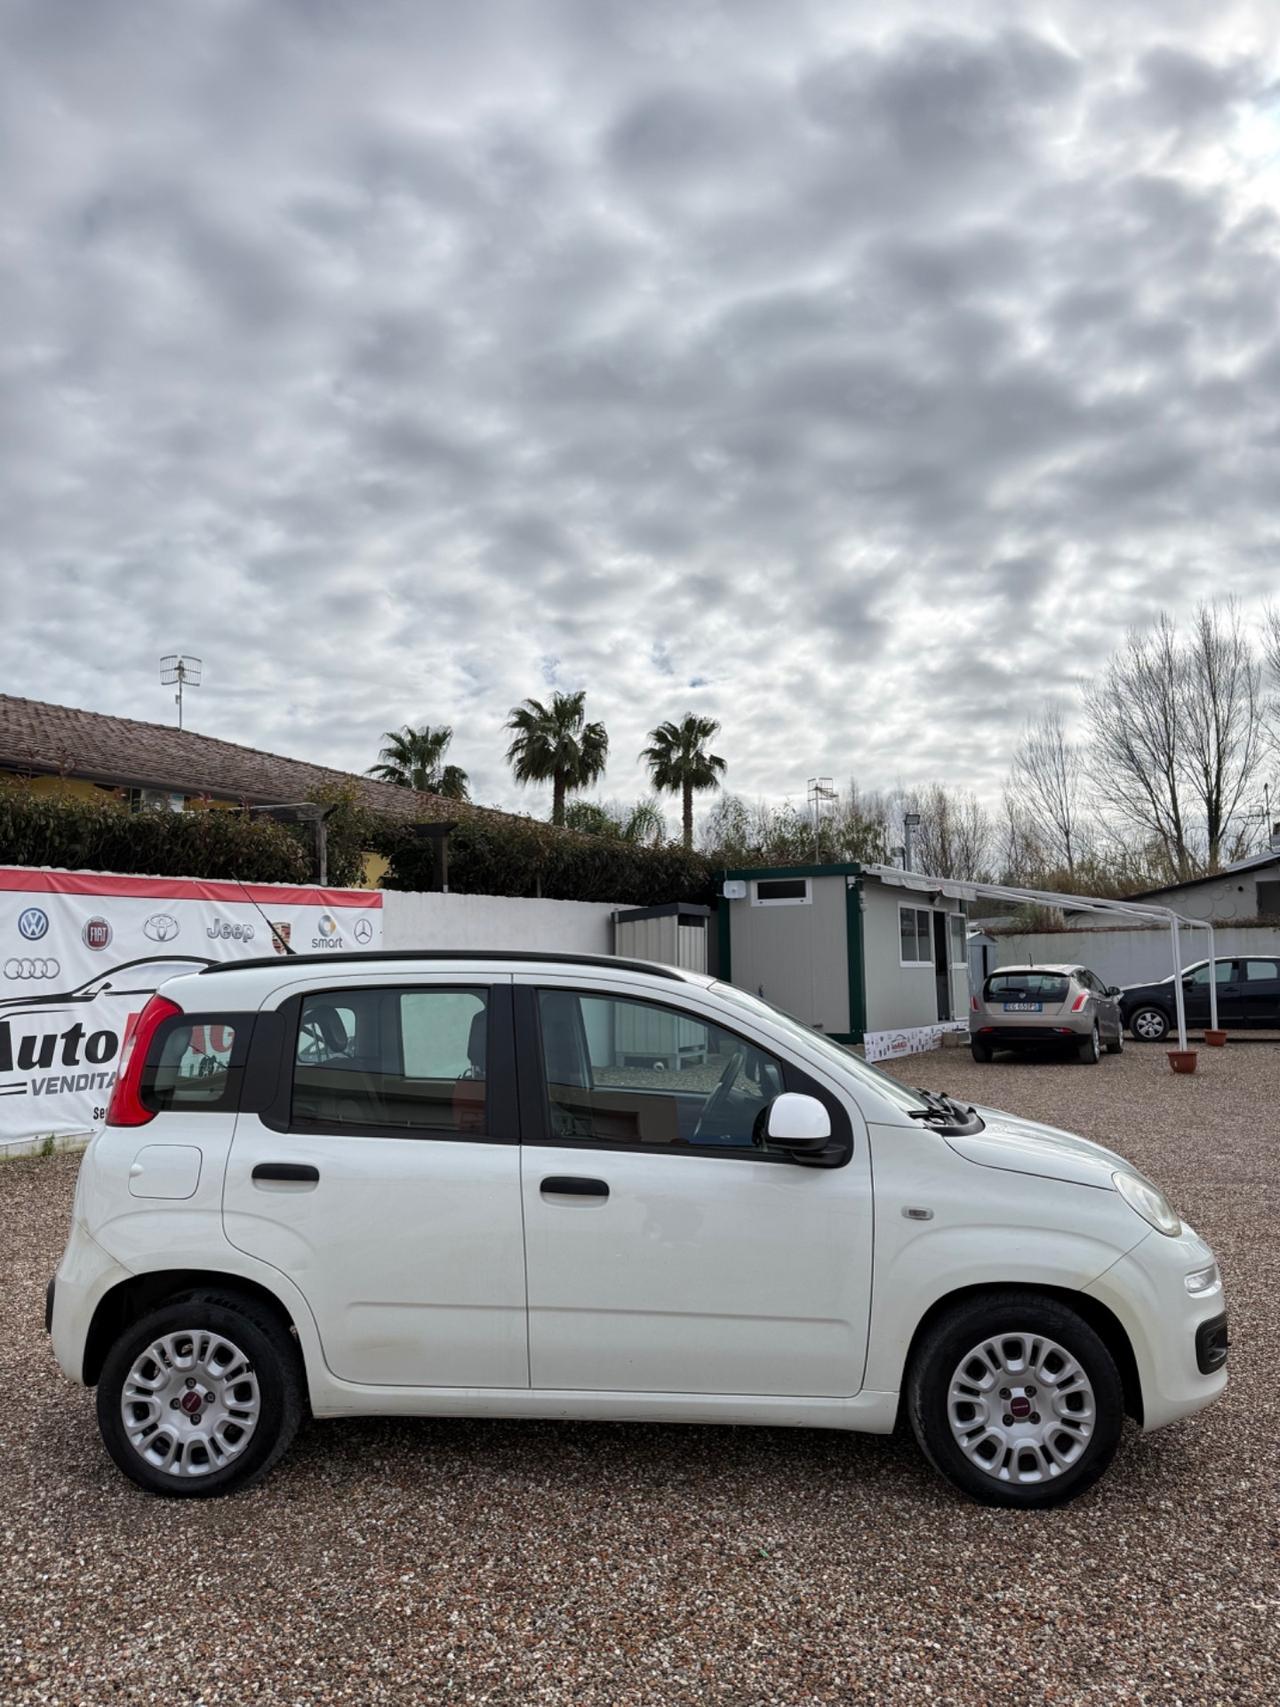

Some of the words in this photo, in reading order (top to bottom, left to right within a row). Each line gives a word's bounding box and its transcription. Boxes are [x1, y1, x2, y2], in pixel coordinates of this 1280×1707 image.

[89, 926, 107, 942] FIAT
[206, 918, 255, 943] Jeep
[311, 937, 343, 949] smart
